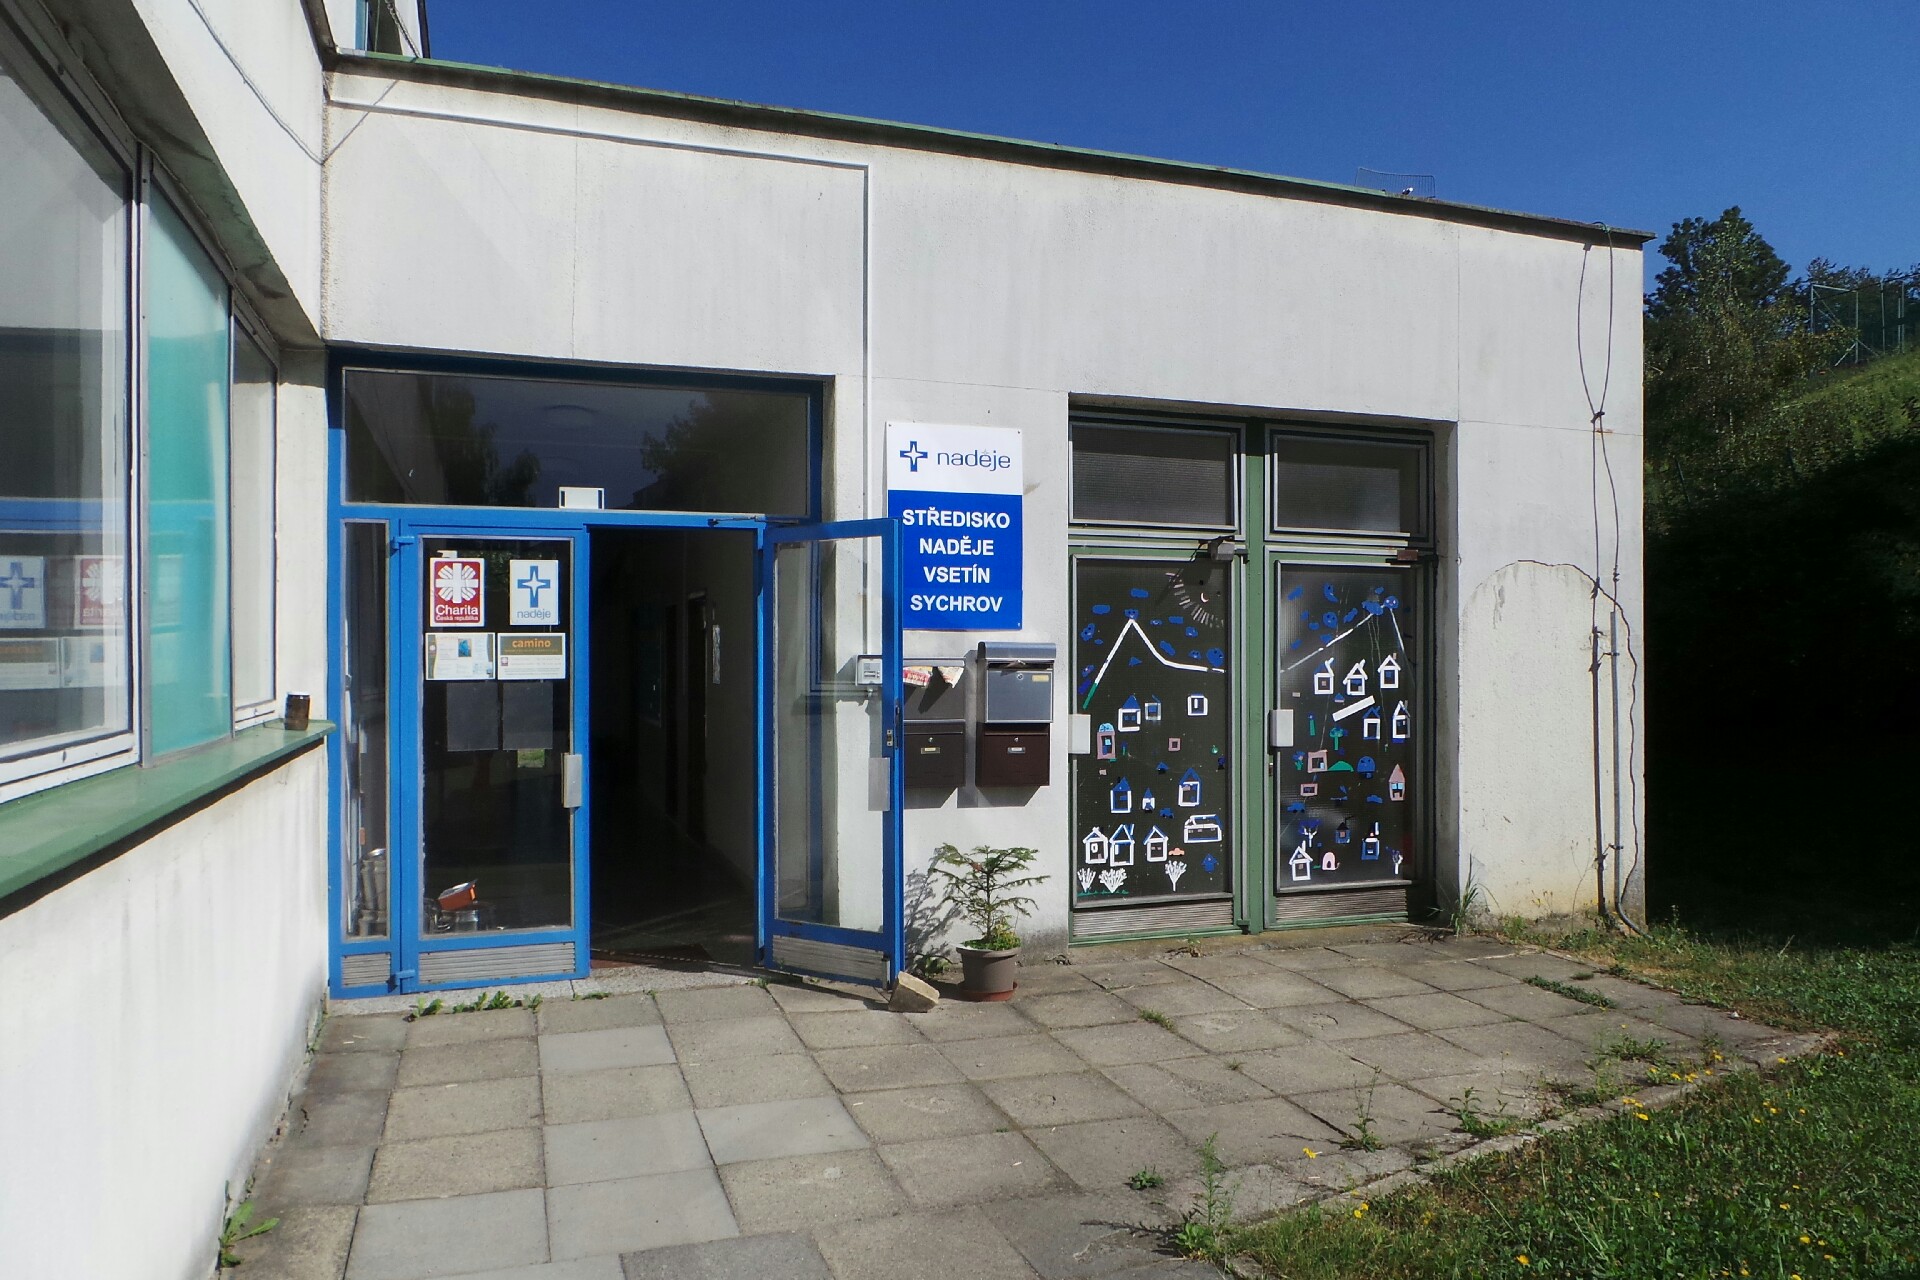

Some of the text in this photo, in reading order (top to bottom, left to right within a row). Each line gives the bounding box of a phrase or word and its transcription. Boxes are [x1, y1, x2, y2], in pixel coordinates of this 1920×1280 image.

[937, 449, 1011, 471] naděje
[903, 507, 1010, 529] STŘEDISKO
[919, 535, 994, 556] NADĚJE
[923, 563, 990, 584] VSETÍN
[435, 604, 479, 615] Charita
[910, 595, 1003, 612] SYCHROV
[512, 638, 551, 648] camino
